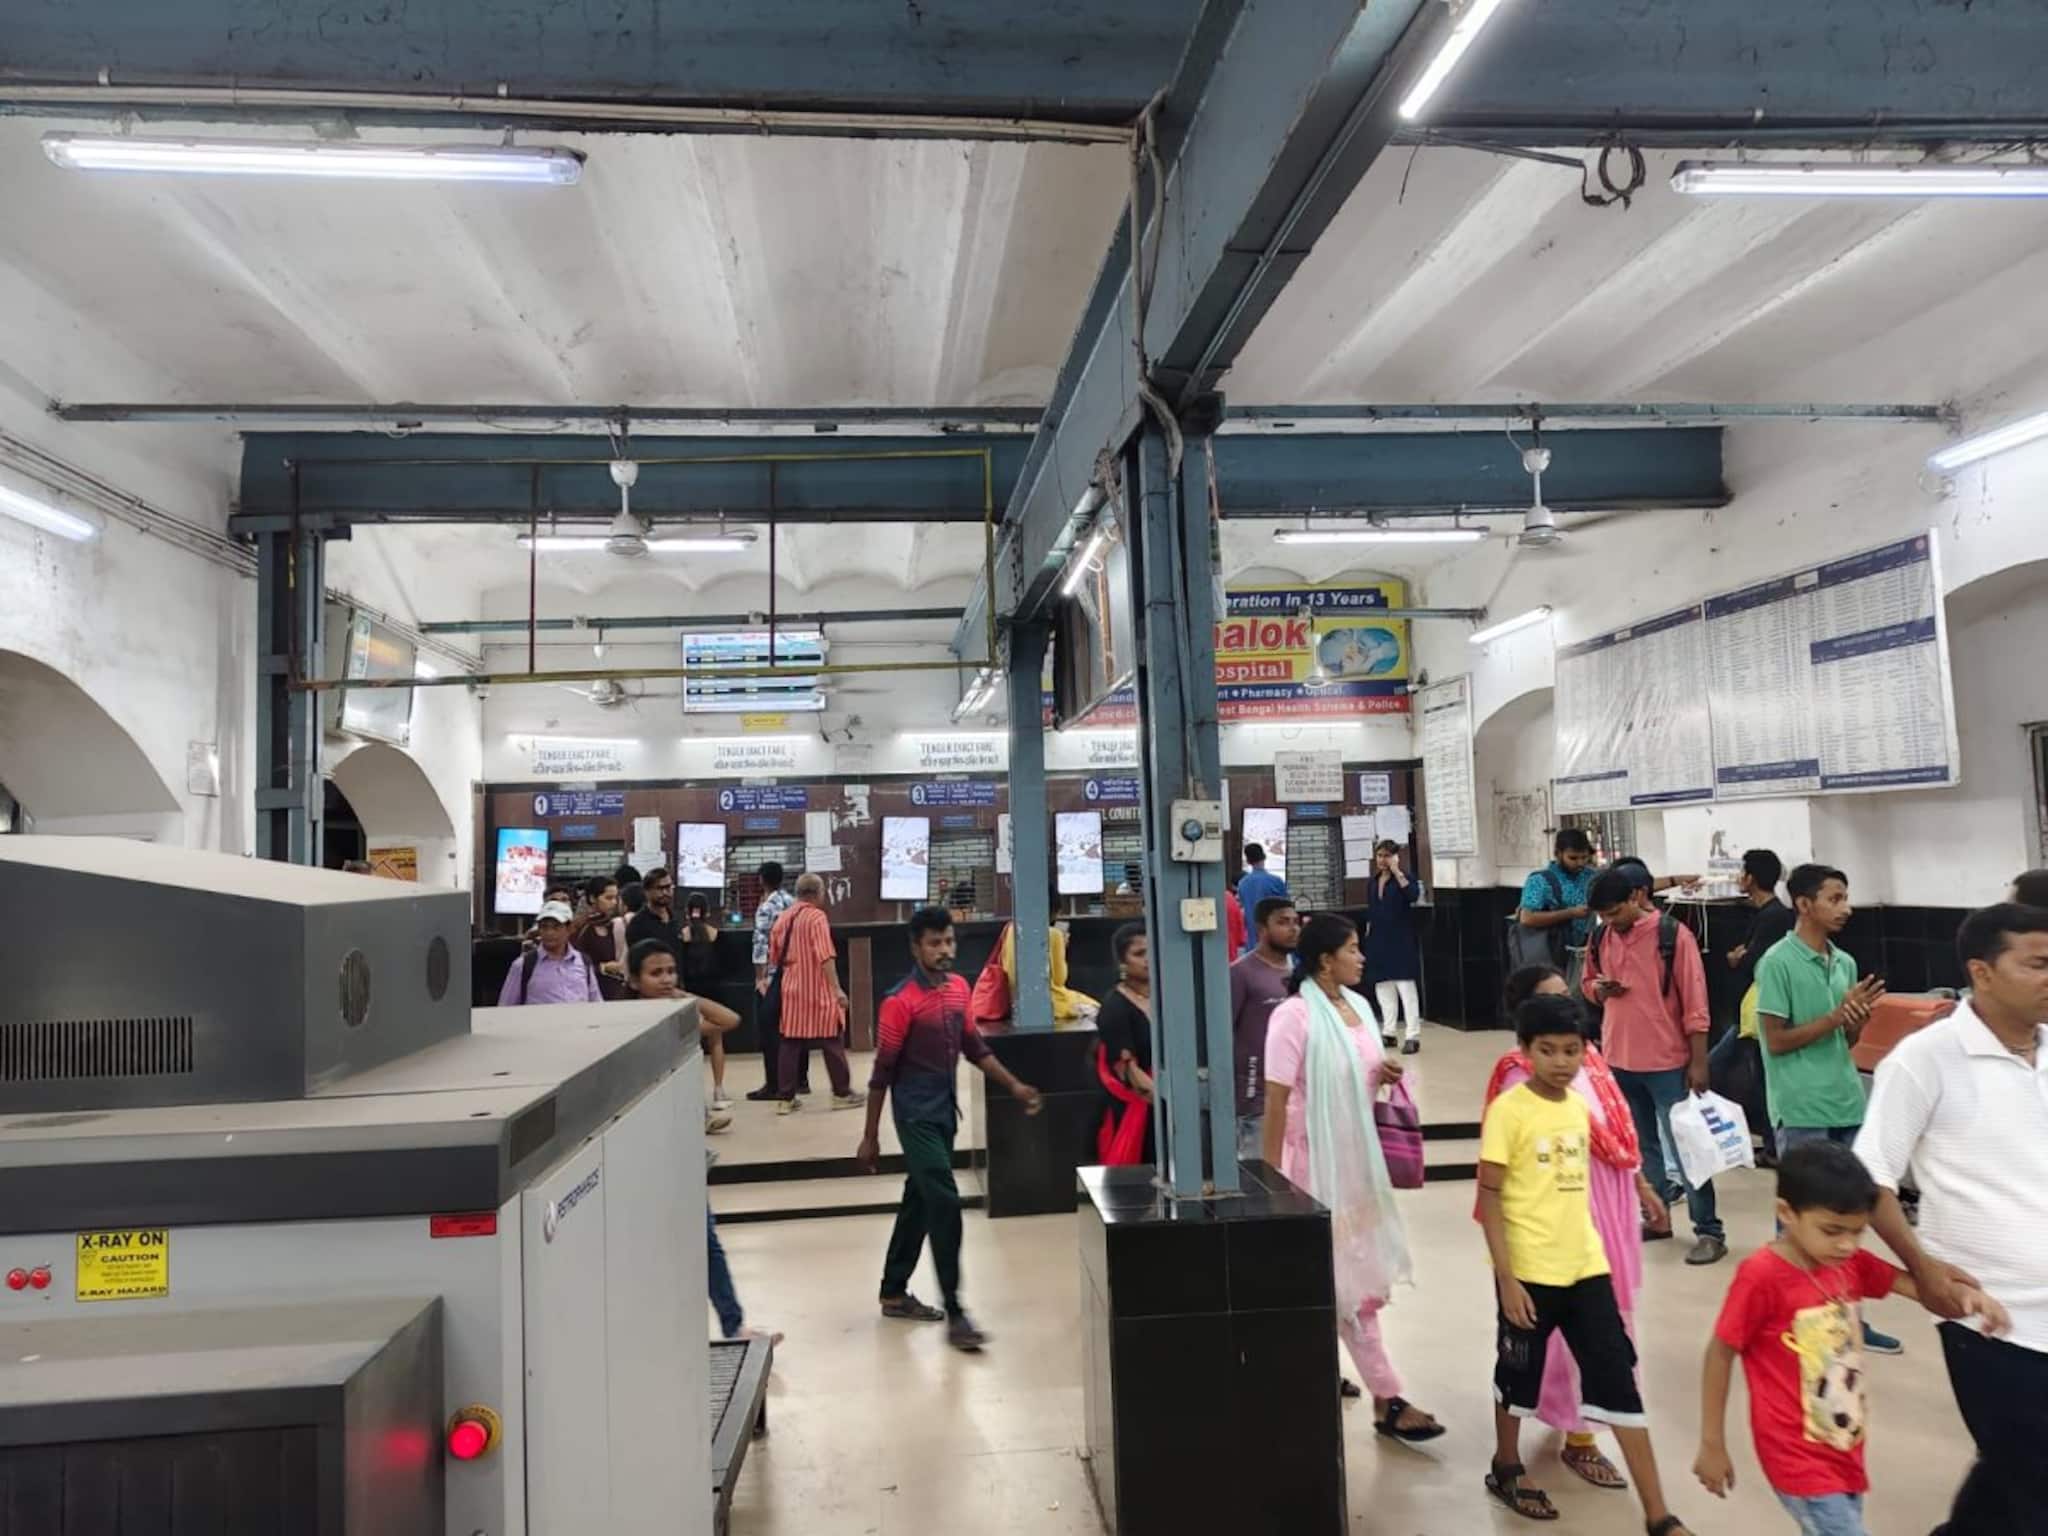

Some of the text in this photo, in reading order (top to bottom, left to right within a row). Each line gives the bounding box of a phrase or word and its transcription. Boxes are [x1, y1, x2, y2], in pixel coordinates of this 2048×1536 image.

[1309, 593, 1324, 607] 13
[1330, 591, 1376, 606] Years
[1241, 687, 1293, 699] Pharmacy
[1238, 704, 1275, 717] Bengal
[1278, 703, 1312, 713] Health
[1313, 702, 1356, 712] Scheme
[1357, 701, 1366, 711] &
[1368, 700, 1400, 710] Police
[82, 1231, 164, 1249] X-RAY ON
[101, 1253, 160, 1264] CAUTION
